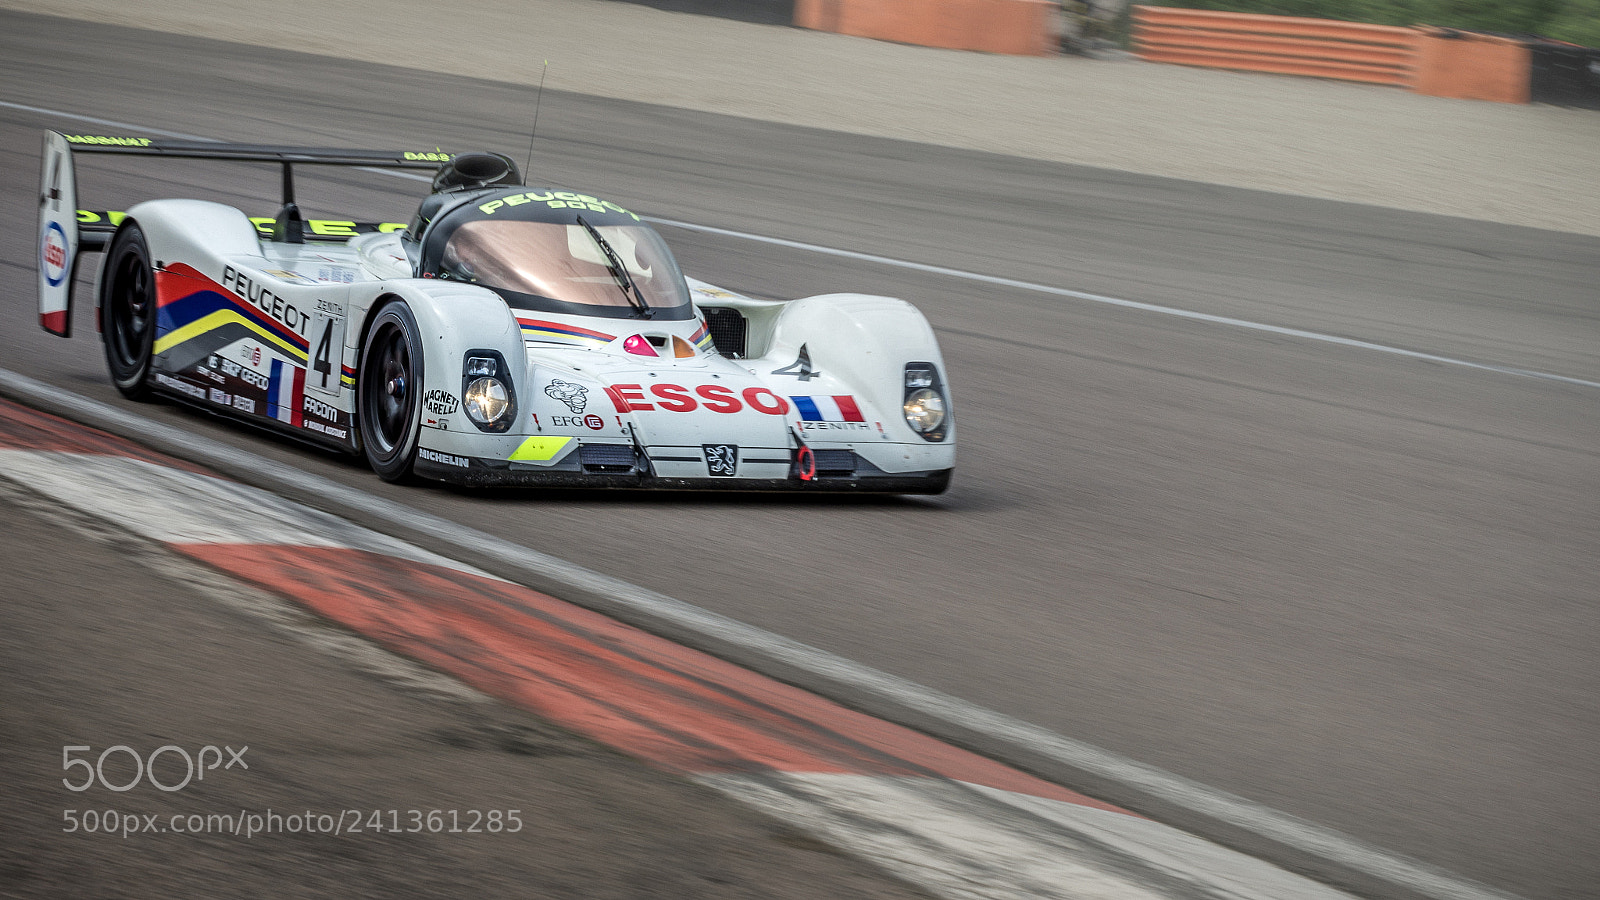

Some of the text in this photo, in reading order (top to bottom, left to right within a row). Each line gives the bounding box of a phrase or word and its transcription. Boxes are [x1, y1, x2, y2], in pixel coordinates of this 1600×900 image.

[222, 264, 310, 336] PEUGEOT
[313, 318, 334, 388] 4
[303, 396, 338, 422] FACOM
[602, 383, 789, 415] ESSO
[551, 415, 584, 427] EFG
[803, 422, 871, 430] ZENITH
[418, 447, 470, 468] MICHELIN
